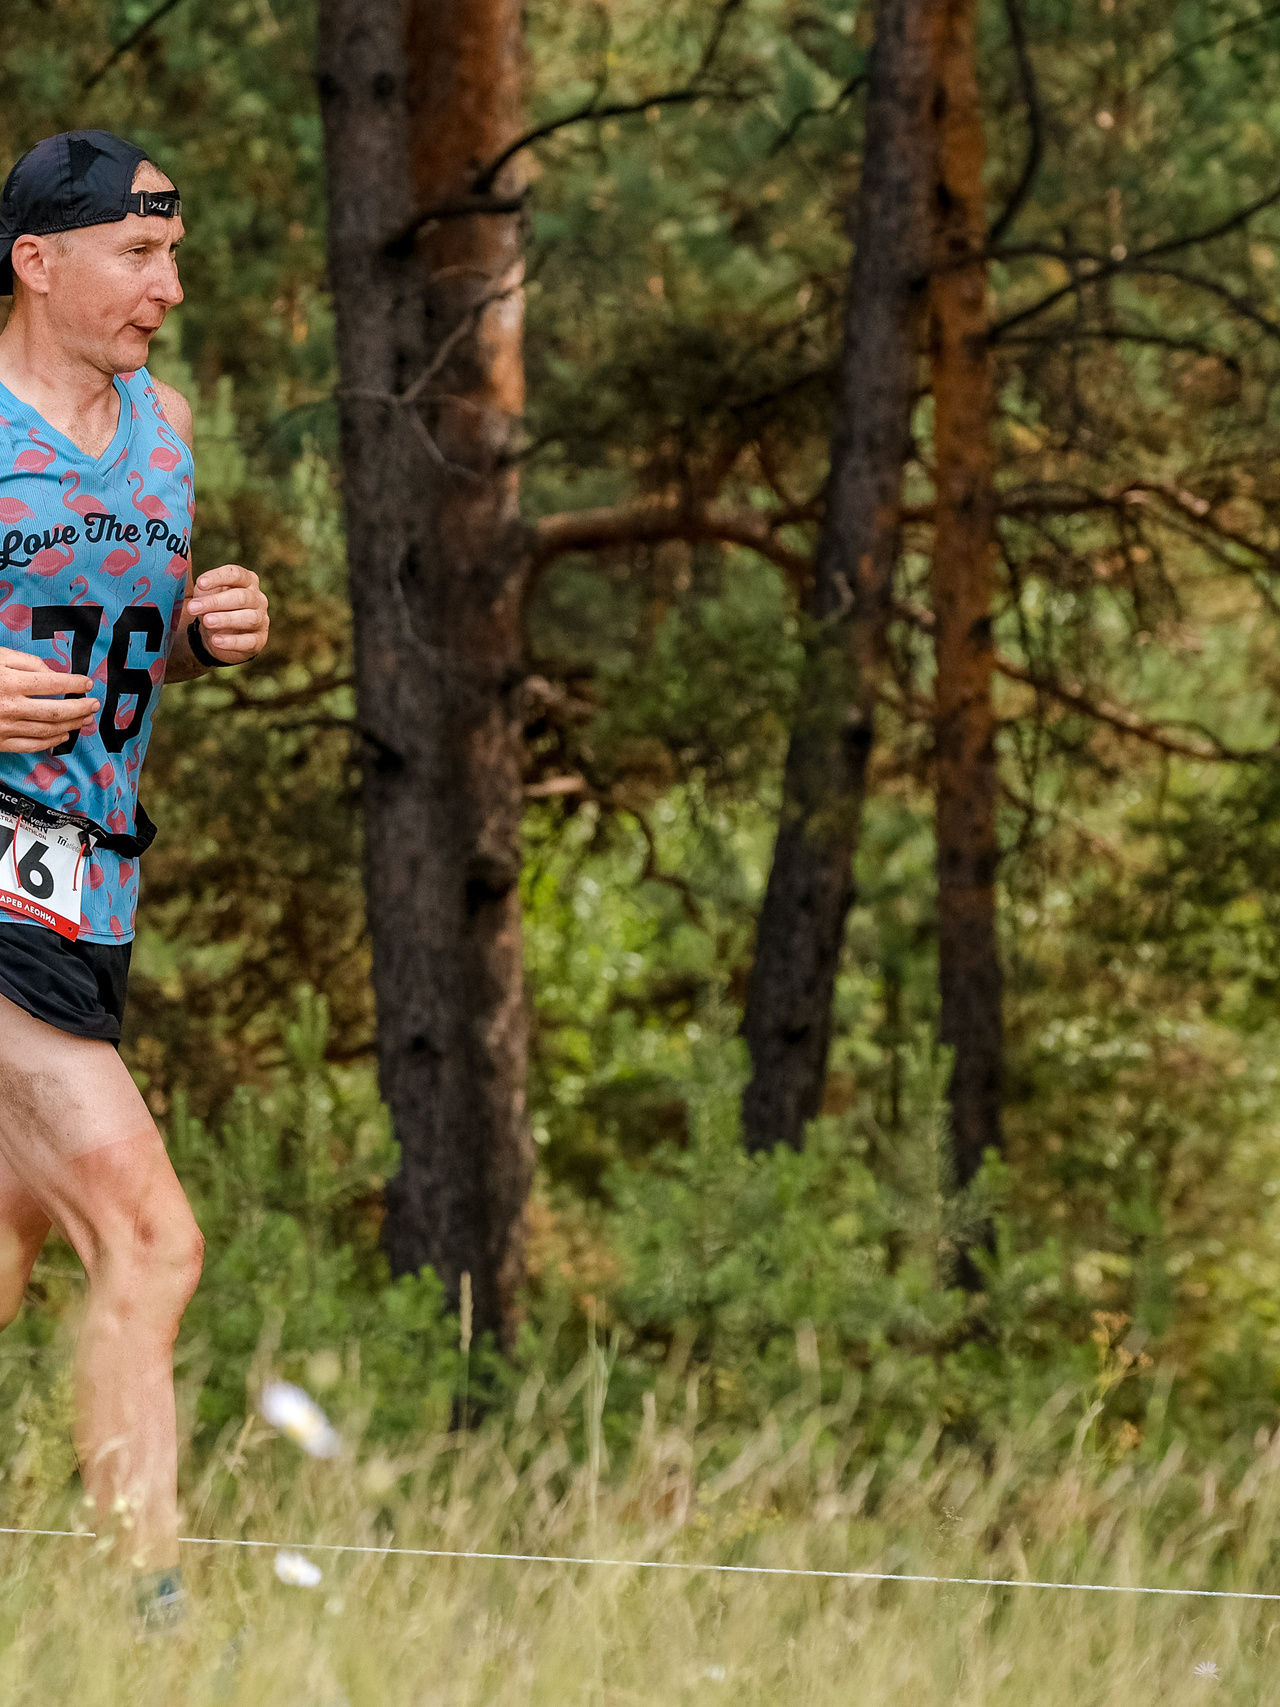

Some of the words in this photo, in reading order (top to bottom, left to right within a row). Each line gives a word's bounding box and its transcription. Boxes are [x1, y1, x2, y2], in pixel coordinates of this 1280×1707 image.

[84, 512, 141, 543] The
[146, 519, 188, 560] Pai
[32, 606, 165, 756] 76
[24, 903, 57, 926] ЛЕОНИД
